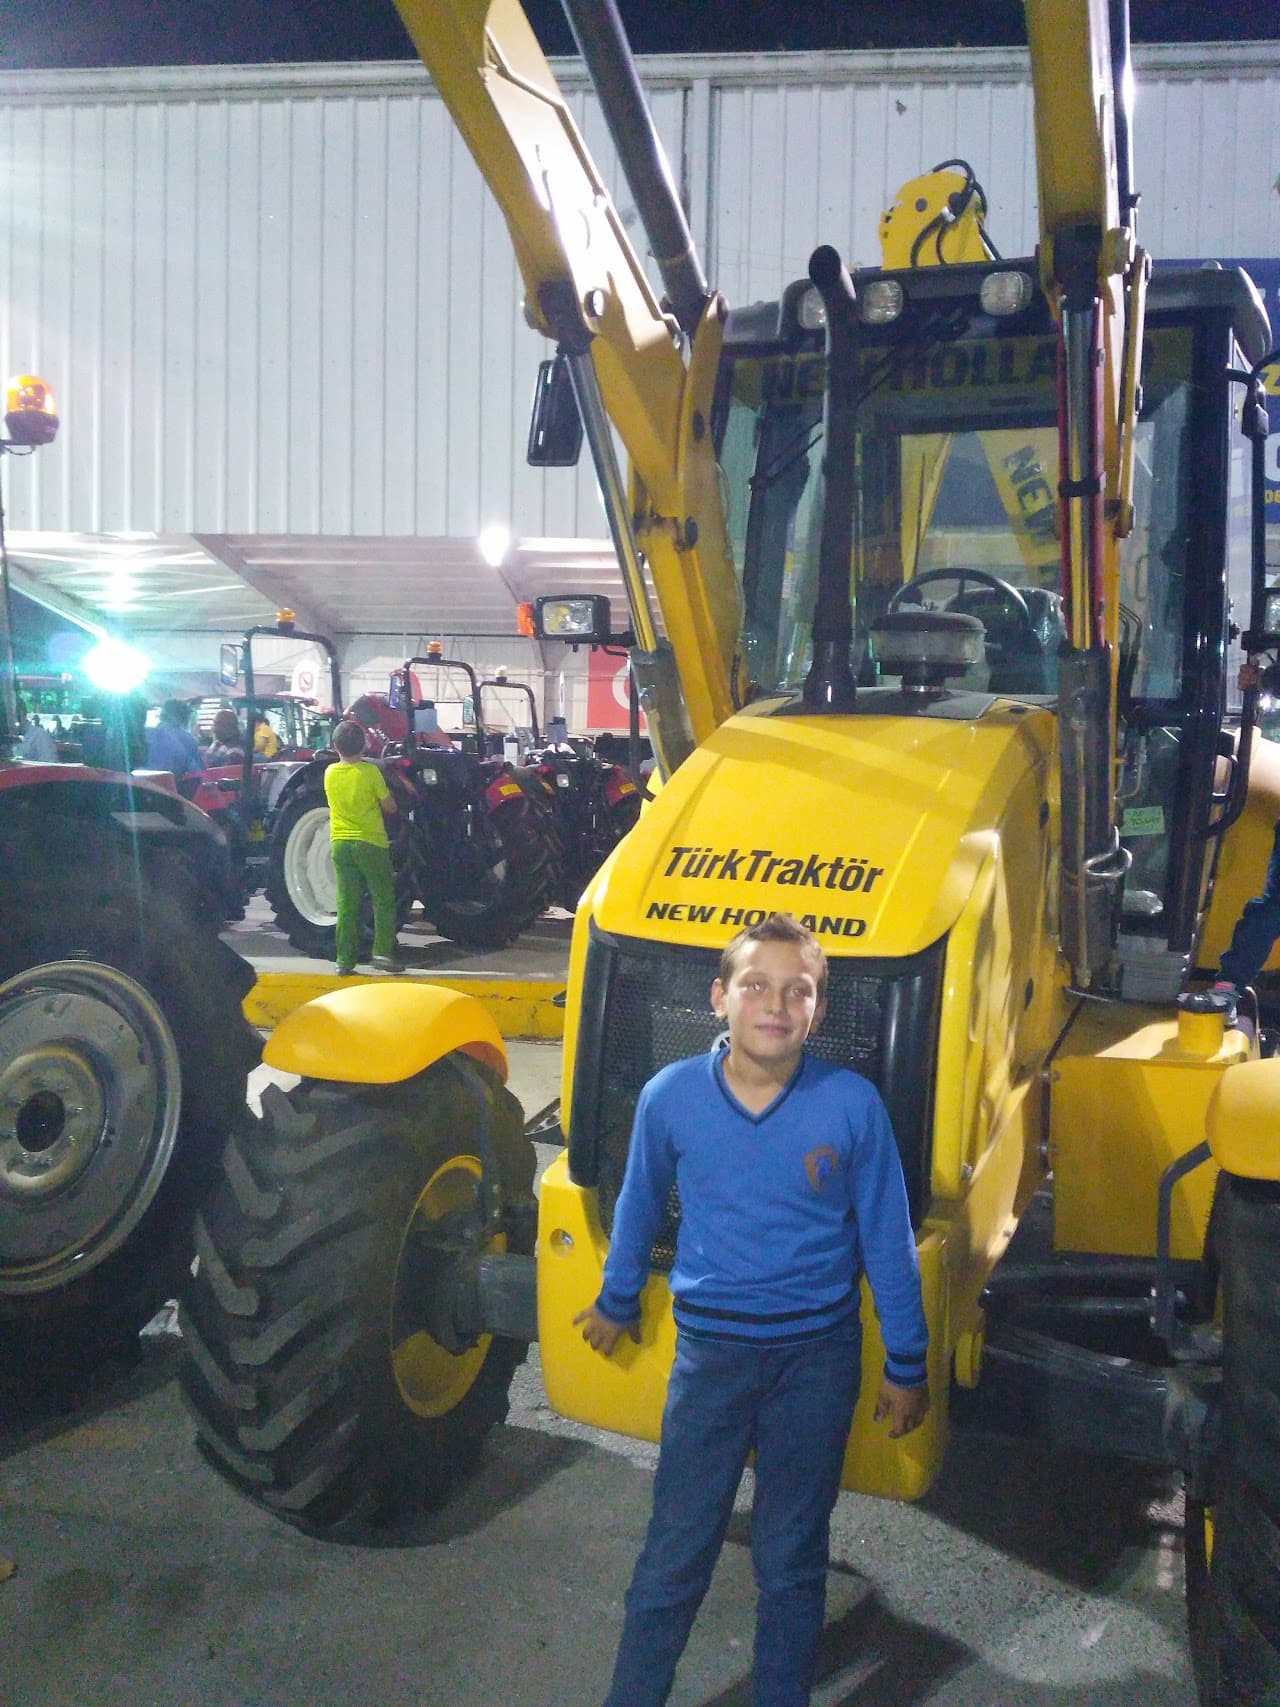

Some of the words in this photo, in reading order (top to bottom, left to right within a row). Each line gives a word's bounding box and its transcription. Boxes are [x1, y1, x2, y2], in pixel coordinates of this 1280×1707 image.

[664, 847, 884, 893] TürkTraktör
[646, 902, 716, 923] NEW
[720, 907, 866, 937] HOAND
